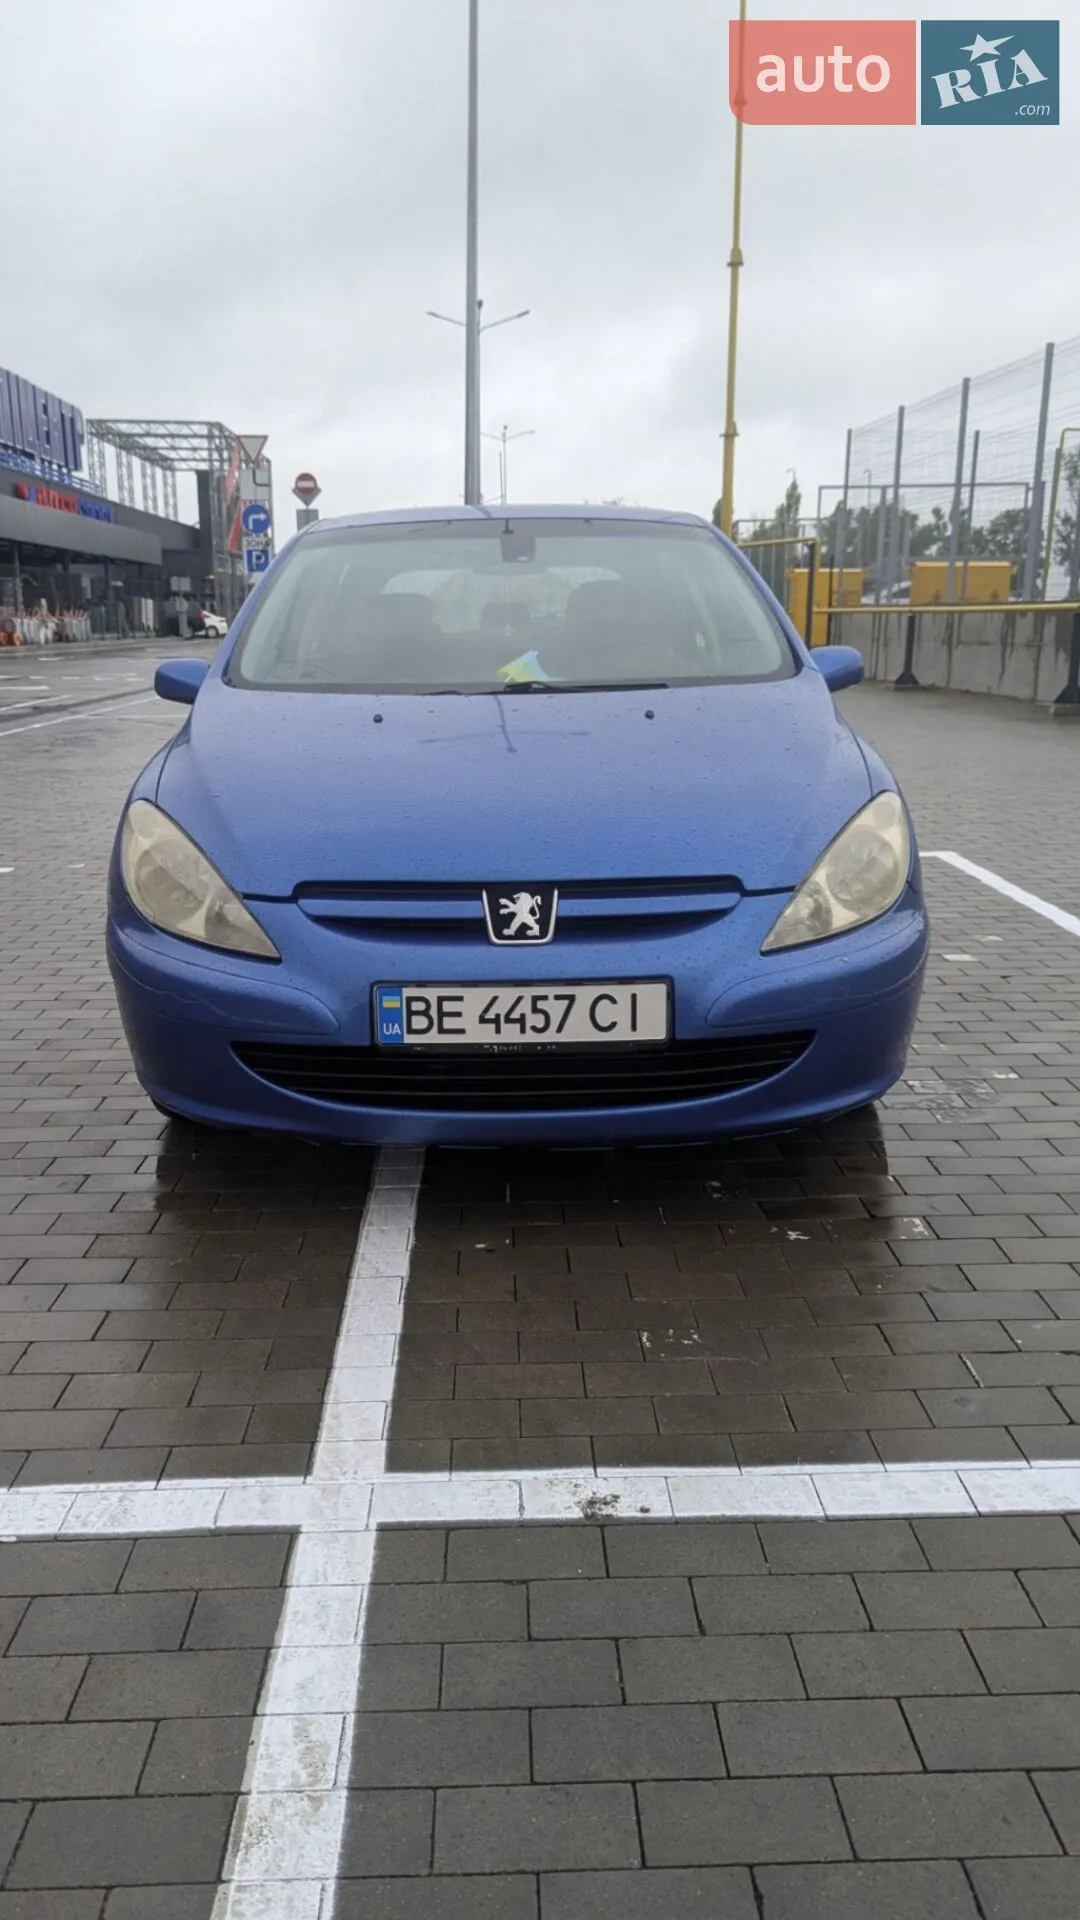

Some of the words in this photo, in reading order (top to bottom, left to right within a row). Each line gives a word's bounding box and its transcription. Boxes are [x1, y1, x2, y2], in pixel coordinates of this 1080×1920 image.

[405, 995, 466, 1036] BE
[478, 994, 576, 1035] 4457
[589, 992, 638, 1033] CI
[383, 1023, 402, 1036] UA
